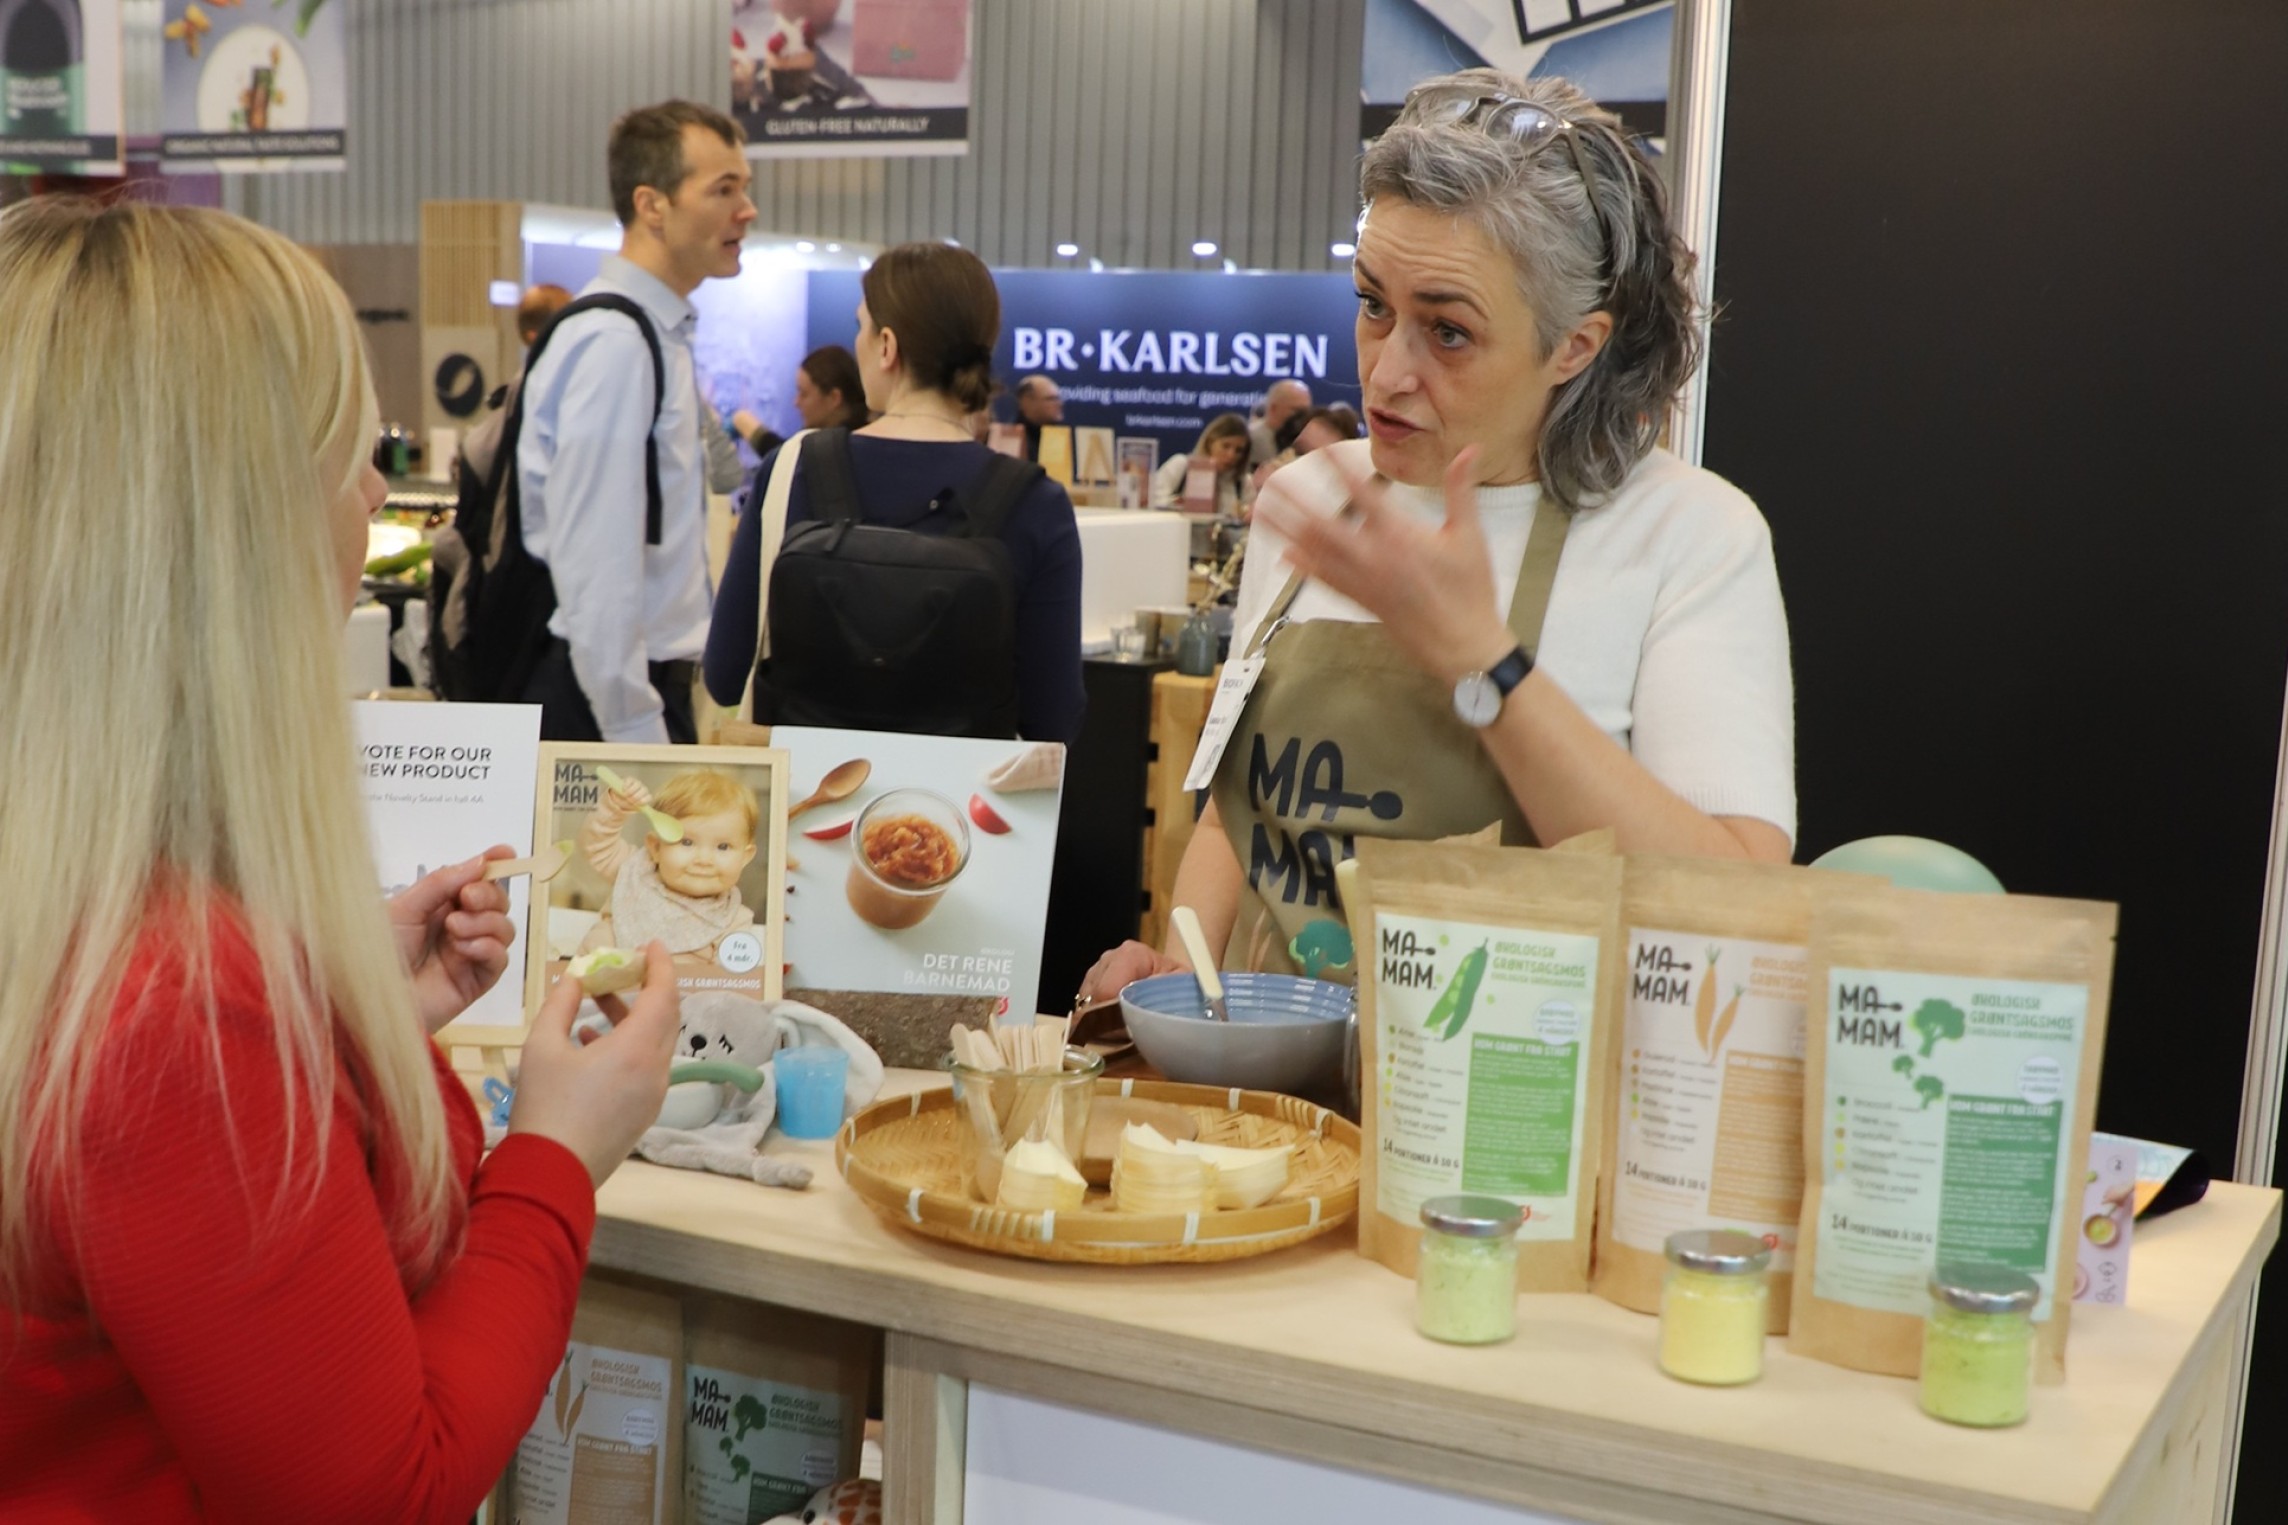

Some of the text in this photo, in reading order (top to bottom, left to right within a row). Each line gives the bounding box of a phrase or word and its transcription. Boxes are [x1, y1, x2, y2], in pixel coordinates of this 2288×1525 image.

[766, 115, 930, 136] GLUTEN-FREE NATURALLY
[1059, 383, 1111, 405] oviding
[1113, 385, 1172, 404] seafood
[1174, 387, 1196, 405] for
[409, 745, 446, 761] FOR
[450, 747, 492, 762] OUR
[402, 763, 492, 780] PRODUCT
[553, 785, 598, 804] MAM
[923, 953, 1013, 975] DET RENE
[1382, 958, 1434, 990] MAM
[903, 968, 1011, 992] BARNEMAD
[1632, 973, 1690, 1006] MAM
[1837, 1016, 1901, 1049] MAM
[1383, 1138, 1393, 1153] 14
[1625, 1161, 1638, 1176] 14
[1832, 1213, 1847, 1230] 14
[690, 1401, 729, 1432] MAM
